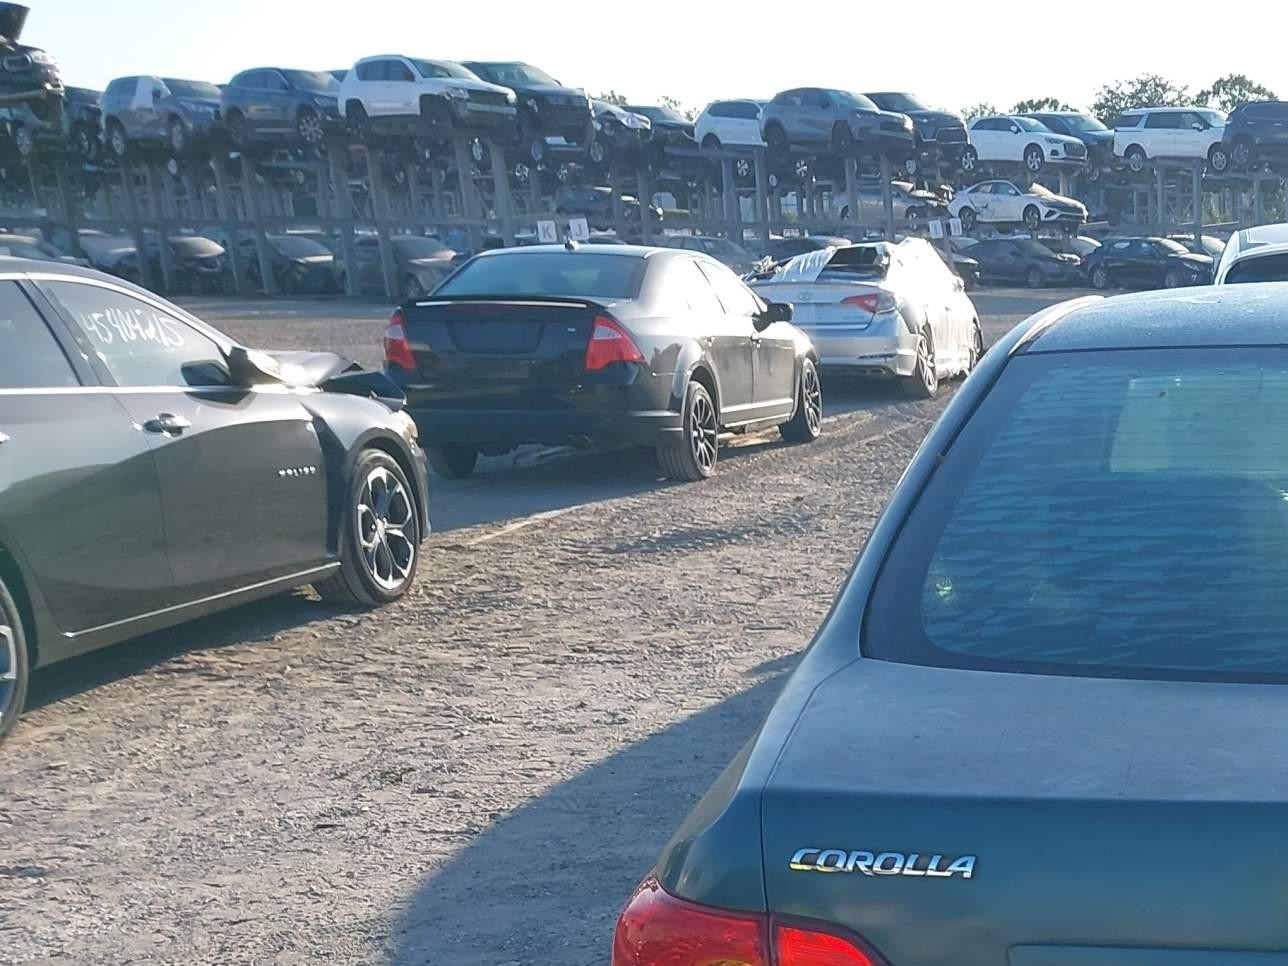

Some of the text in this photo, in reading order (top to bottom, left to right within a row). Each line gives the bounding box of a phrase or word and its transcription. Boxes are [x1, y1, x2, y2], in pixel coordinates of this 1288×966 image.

[541, 223, 554, 239] K
[575, 223, 583, 237] J
[789, 848, 977, 879] COROLLA
